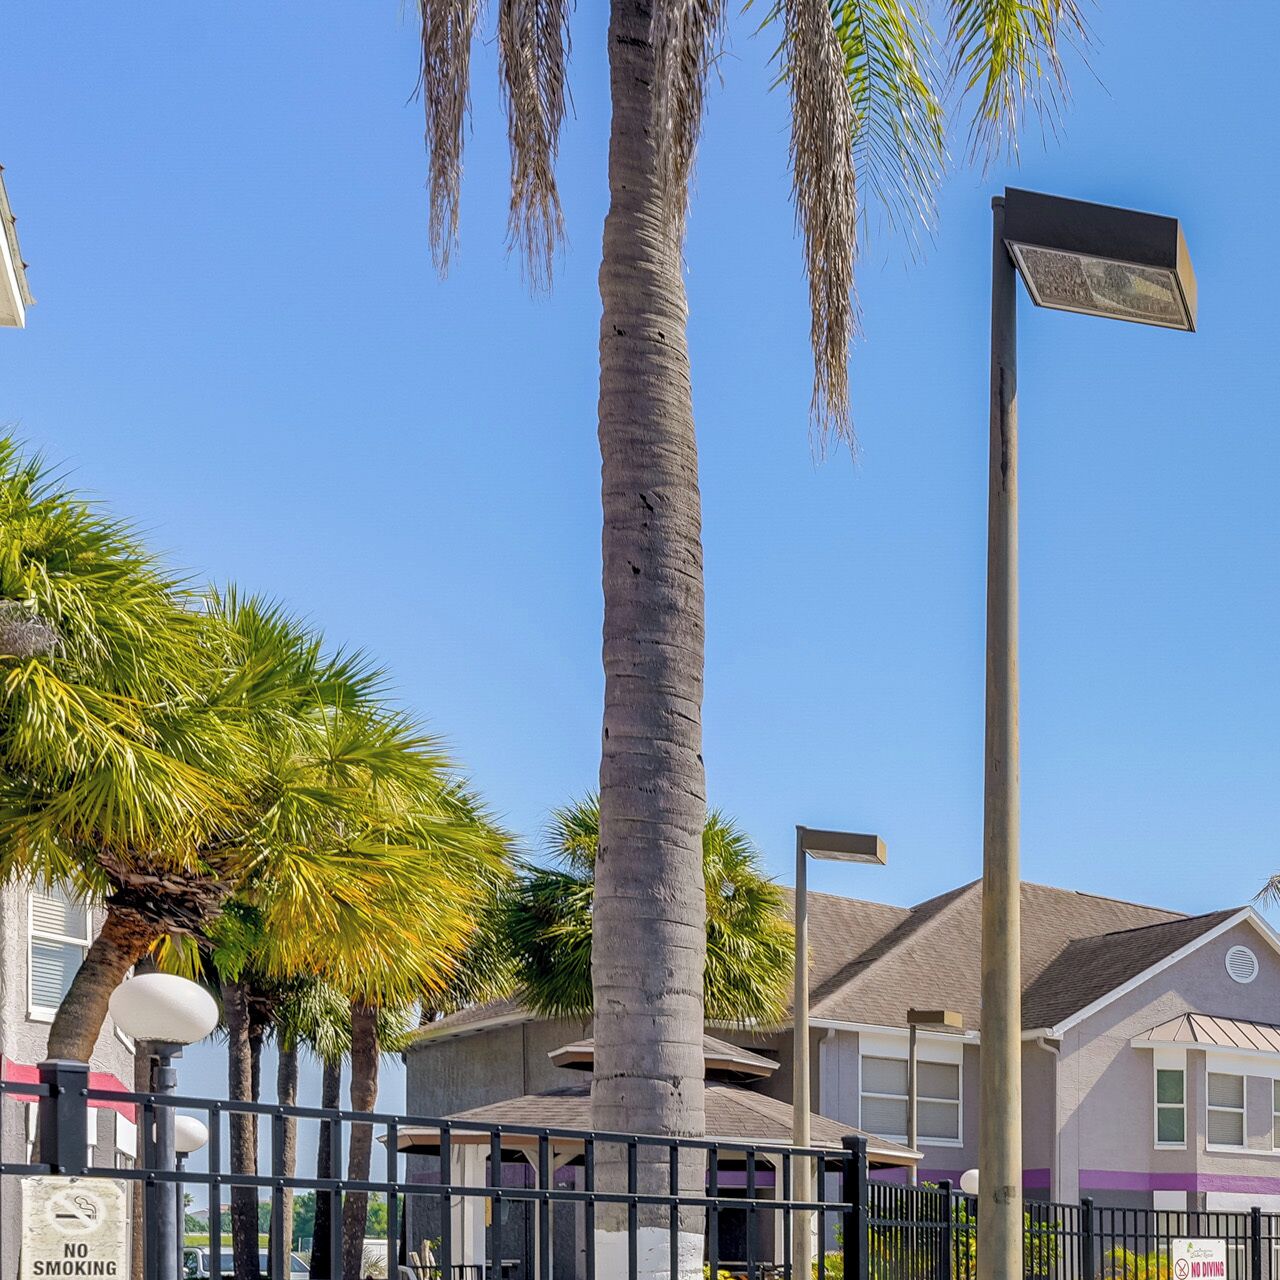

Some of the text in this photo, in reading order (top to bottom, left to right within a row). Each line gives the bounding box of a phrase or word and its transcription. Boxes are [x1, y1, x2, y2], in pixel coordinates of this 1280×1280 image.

[64, 1243, 88, 1258] NO
[33, 1261, 117, 1276] SMOKING
[1191, 1261, 1224, 1278] NO DIVING
